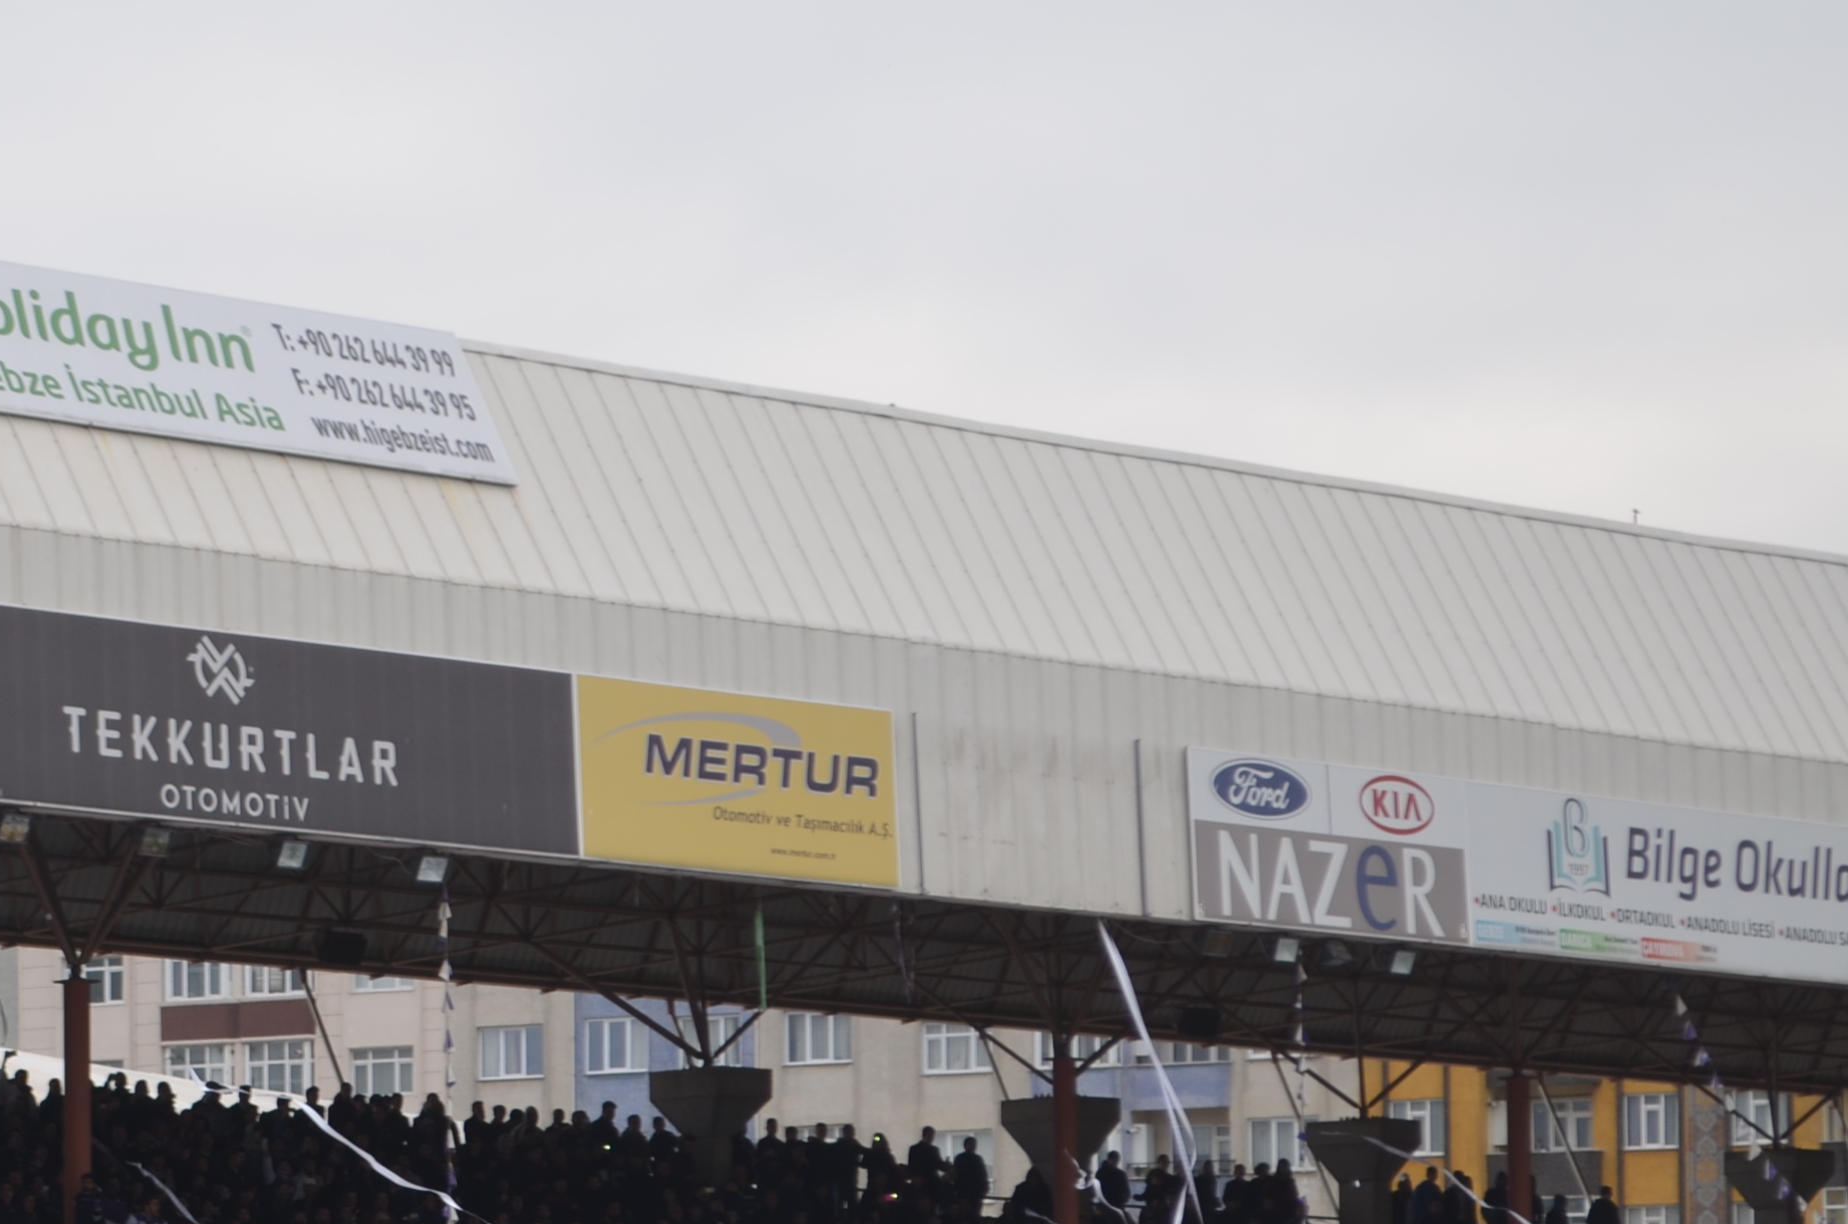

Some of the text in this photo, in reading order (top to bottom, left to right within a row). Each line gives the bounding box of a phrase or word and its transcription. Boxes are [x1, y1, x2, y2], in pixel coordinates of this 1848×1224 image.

[160, 304, 255, 372] Inn
[270, 323, 456, 377] T: +90 262 644 39 99
[64, 363, 208, 420] İstanbul
[214, 392, 286, 431] Asia
[317, 373, 353, 402] +90
[350, 377, 389, 408] 262
[389, 383, 426, 414] 644
[423, 388, 449, 417] 39
[450, 393, 477, 421] 95
[310, 416, 495, 462] www.higebzeist.com
[62, 705, 400, 787] TEKKURTLAR
[644, 732, 880, 798] MERTUR
[159, 784, 310, 822] OTOMOTİV
[712, 806, 772, 824] Otomotiv
[776, 815, 791, 828] ve
[795, 814, 865, 835] Taşımacılık
[1228, 766, 1423, 822] Ford KIA
[1627, 826, 1722, 901] Bilge
[1480, 893, 1506, 910] ANA
[1509, 896, 1548, 915] OKULU
[1557, 898, 1606, 922] İLKOKUL
[1616, 908, 1676, 929] ORTAOKUL
[1685, 915, 1739, 937] ANADOLU
[1785, 925, 1837, 945] ANADOLU
